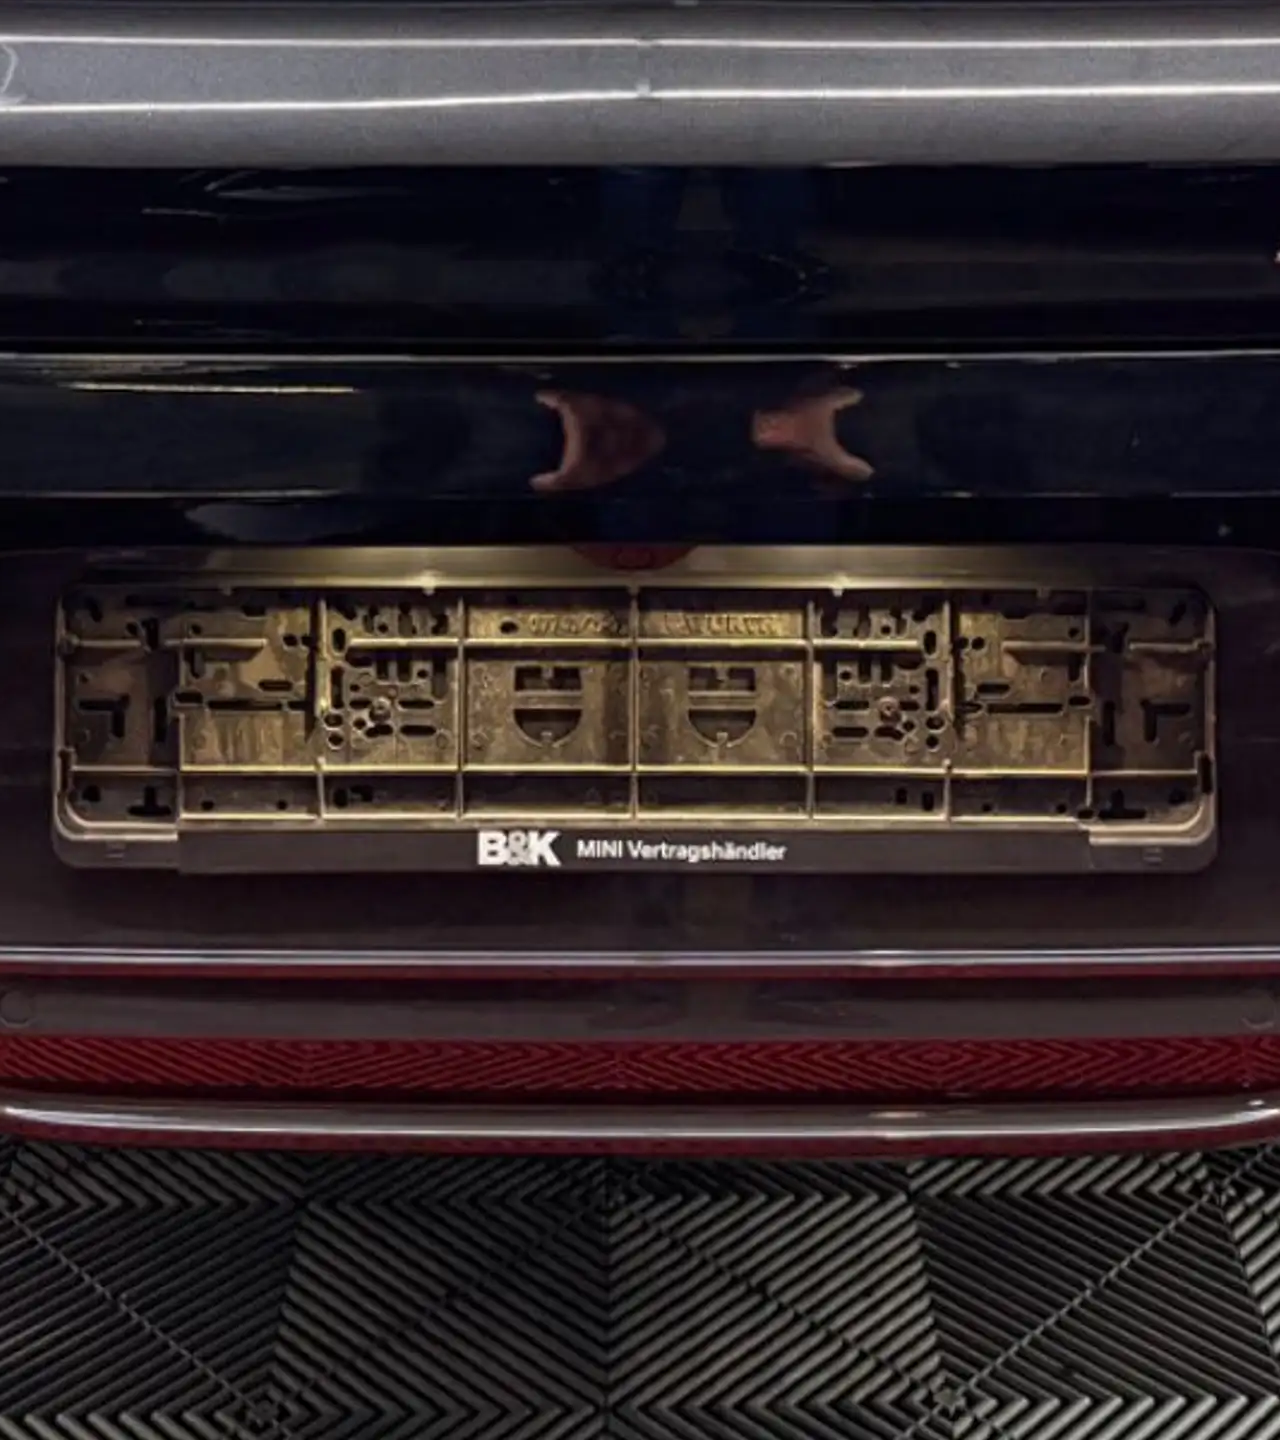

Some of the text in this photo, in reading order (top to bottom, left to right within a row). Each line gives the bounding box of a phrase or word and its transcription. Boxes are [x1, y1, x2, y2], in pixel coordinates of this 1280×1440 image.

[478, 830, 787, 866] B&K MINI Vertragshändler
